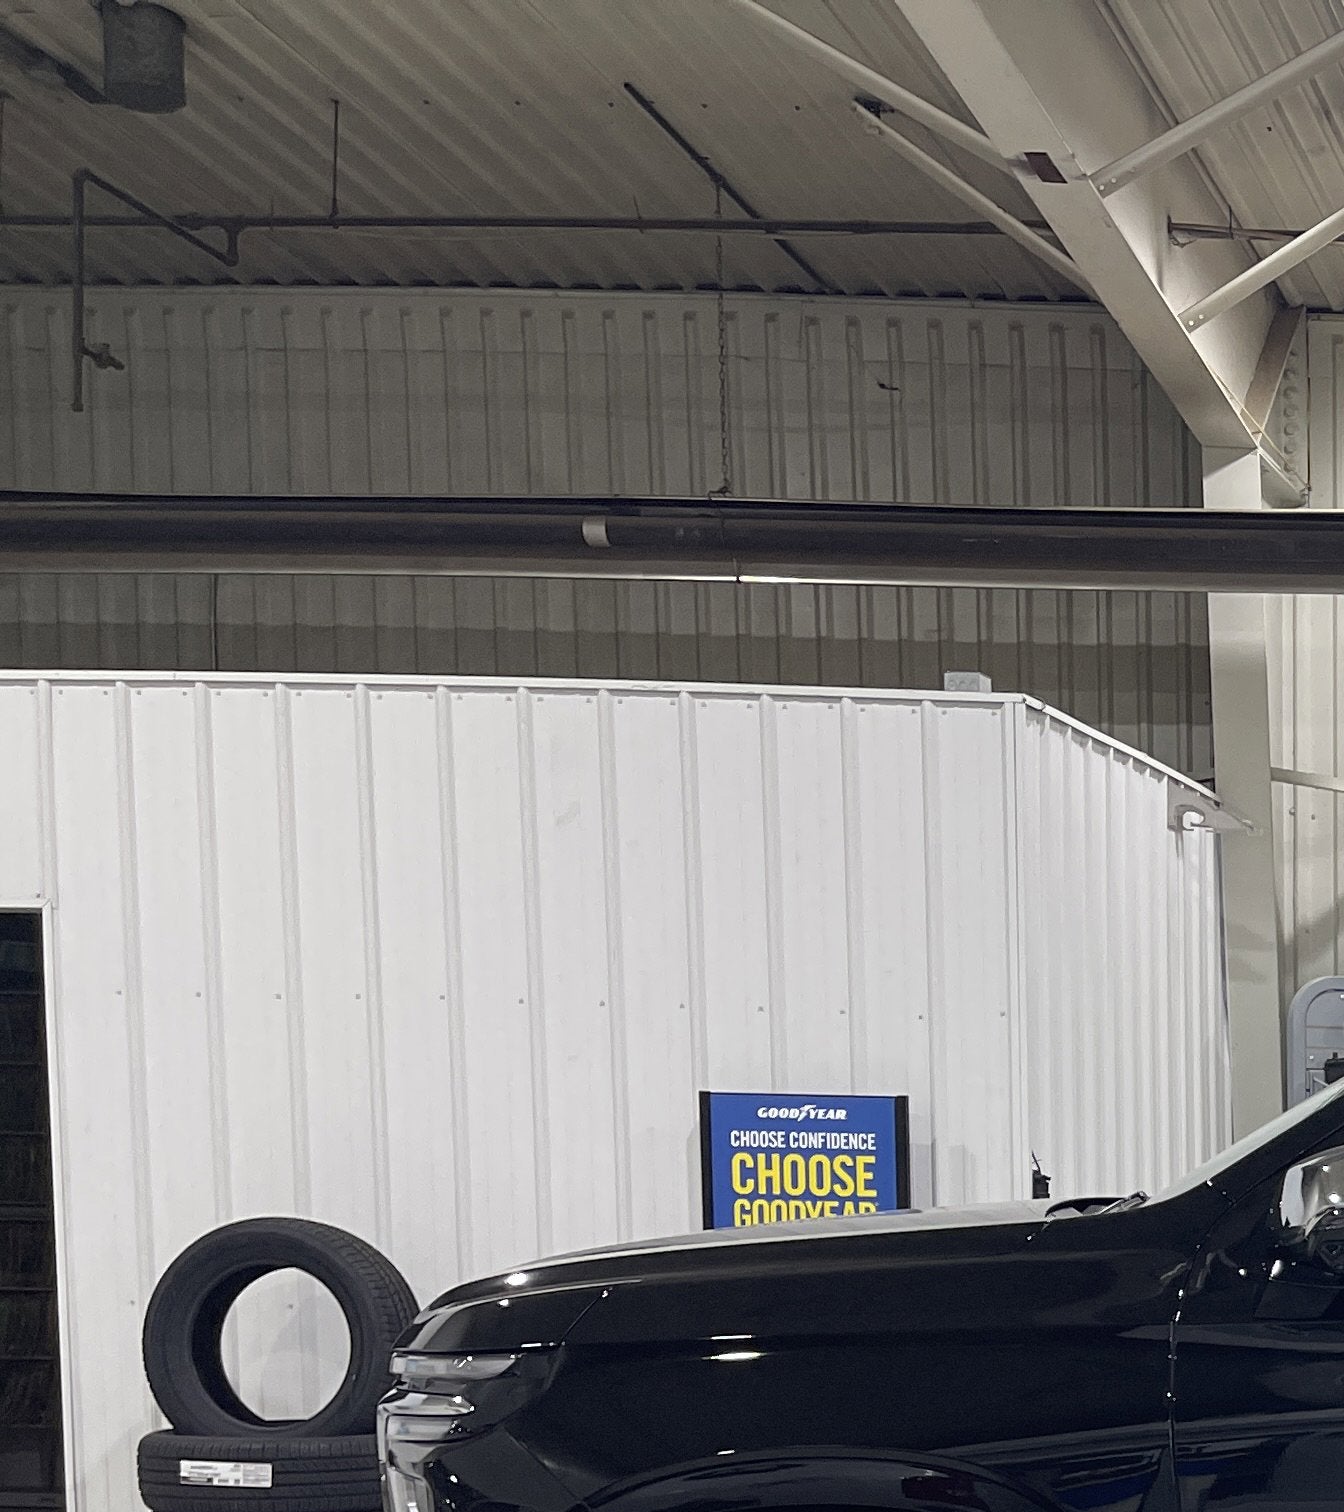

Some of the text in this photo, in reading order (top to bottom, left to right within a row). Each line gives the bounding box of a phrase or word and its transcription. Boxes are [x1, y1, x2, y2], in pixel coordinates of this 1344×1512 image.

[757, 1104, 847, 1122] GOODYEAR
[730, 1130, 876, 1150] CHOOSE CONFIDENCE
[731, 1152, 877, 1197] CHOOSE
